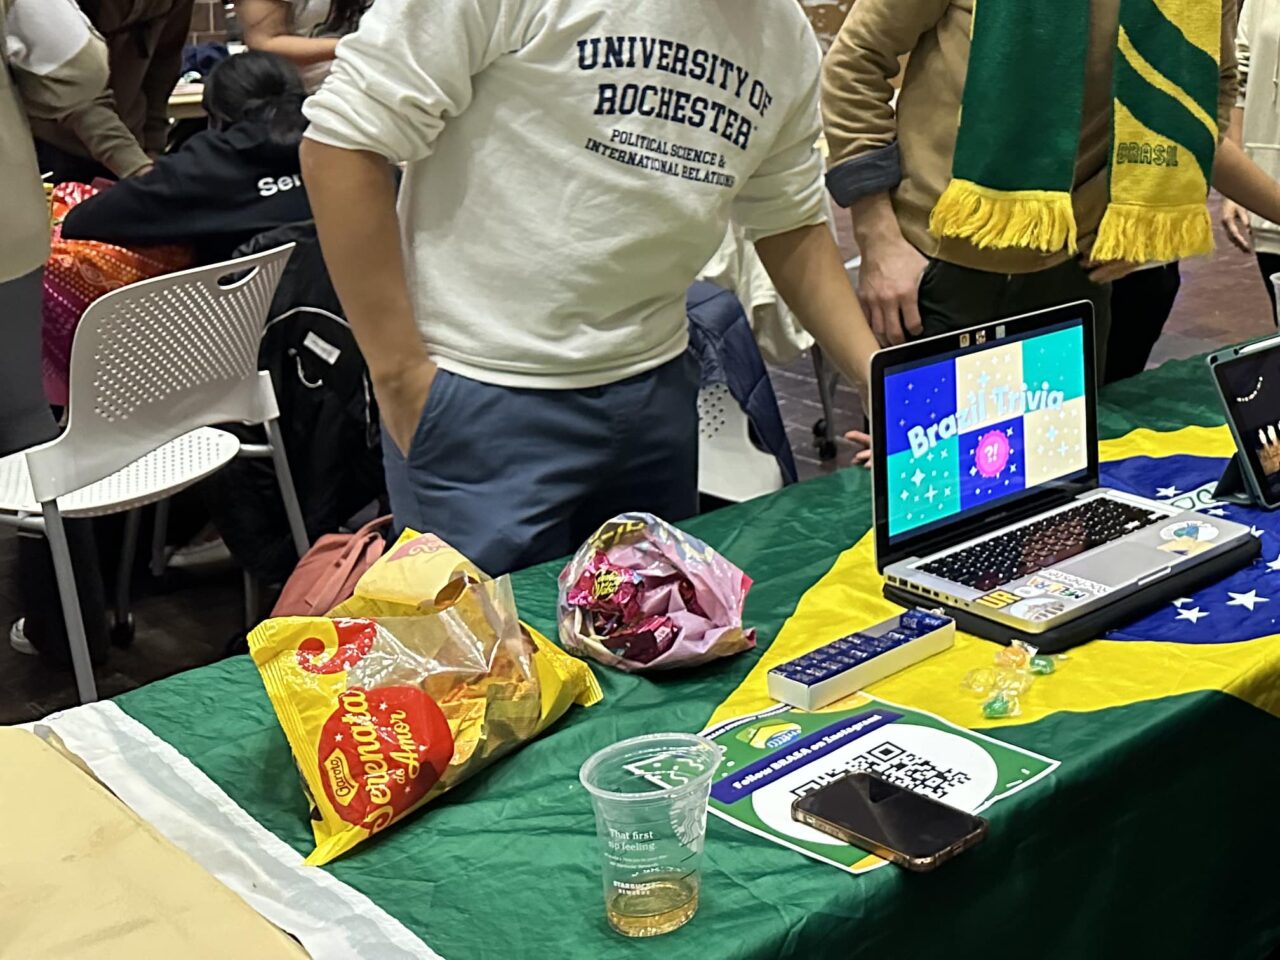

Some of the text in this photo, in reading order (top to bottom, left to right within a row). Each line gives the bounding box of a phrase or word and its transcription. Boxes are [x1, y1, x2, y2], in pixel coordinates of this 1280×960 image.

[576, 36, 774, 117] UNIVERSITY OF
[594, 84, 753, 150] ROCHESTER
[584, 138, 736, 188] INTERNATIONAL RELATIONS
[610, 129, 726, 169] POLITICAL SCIENCE &
[1116, 142, 1178, 167] BRASIL
[908, 381, 1064, 459] Brazil Trivia
[975, 590, 1023, 609] UR
[341, 689, 394, 833] Serenata
[390, 710, 420, 780] Amor
[732, 766, 773, 790] Follow
[770, 748, 812, 770] BRASA
[810, 742, 826, 751] on
[330, 756, 351, 798] Garoto
[608, 828, 653, 840] That first
